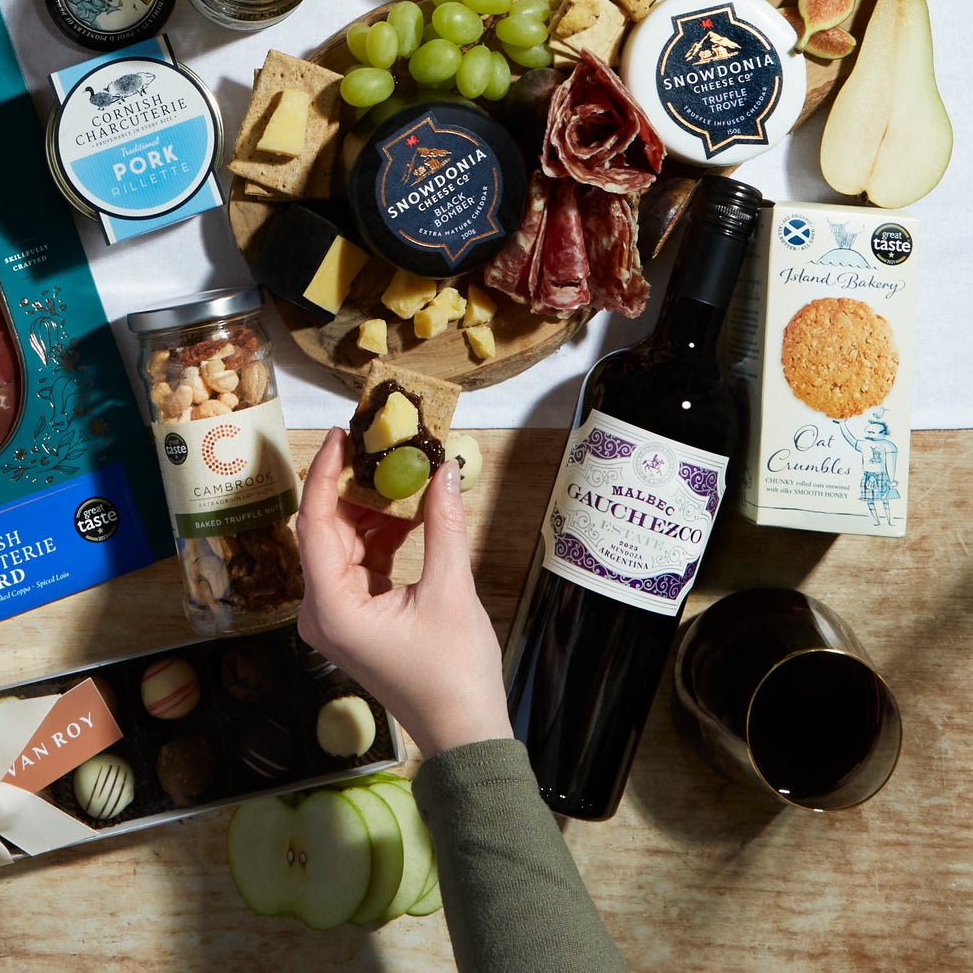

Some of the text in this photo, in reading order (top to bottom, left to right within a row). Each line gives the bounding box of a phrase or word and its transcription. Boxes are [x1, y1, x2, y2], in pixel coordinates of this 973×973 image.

[663, 54, 774, 91] SNOWDONIA
[693, 77, 735, 94] CHEESE
[91, 94, 163, 127] CORNISH
[683, 86, 768, 127] TRUFFLE INFUSED CHEDDAR
[702, 88, 747, 106] TRUFFLE
[709, 99, 745, 114] TROVE
[75, 98, 188, 146] CHARCUTERIE
[96, 133, 132, 148] PROVENANCE
[141, 122, 160, 131] EVERY
[161, 116, 174, 124] BITE
[121, 136, 160, 158] Traditional
[112, 144, 179, 182] PORK
[111, 162, 190, 198] RILLETTE
[387, 148, 487, 219] SNOWDONIA
[418, 184, 456, 212] CHEESE
[418, 185, 488, 237] EXTRA MATURE CHEDDAR
[434, 192, 466, 217] BLACK
[434, 197, 475, 228] BOMBER
[873, 231, 911, 252] great taste
[13, 255, 47, 272] CRAFTED
[779, 267, 906, 300] Island Bakery
[165, 443, 187, 455] taste
[793, 424, 835, 451] Oat
[766, 448, 851, 475] Crumbles
[193, 472, 274, 497] CAMBROOK
[567, 482, 703, 545] GAUCHEZCO
[612, 484, 676, 516] MALBEC
[77, 504, 118, 533] great taste
[195, 519, 222, 529] BAKED
[225, 510, 262, 524] TRUFFLE
[601, 519, 664, 551] ESTATE
[619, 540, 639, 551] 2023
[599, 548, 650, 570] ARGENTINA
[610, 544, 643, 560] MENDOZA
[7, 711, 94, 777] VAN ROY
